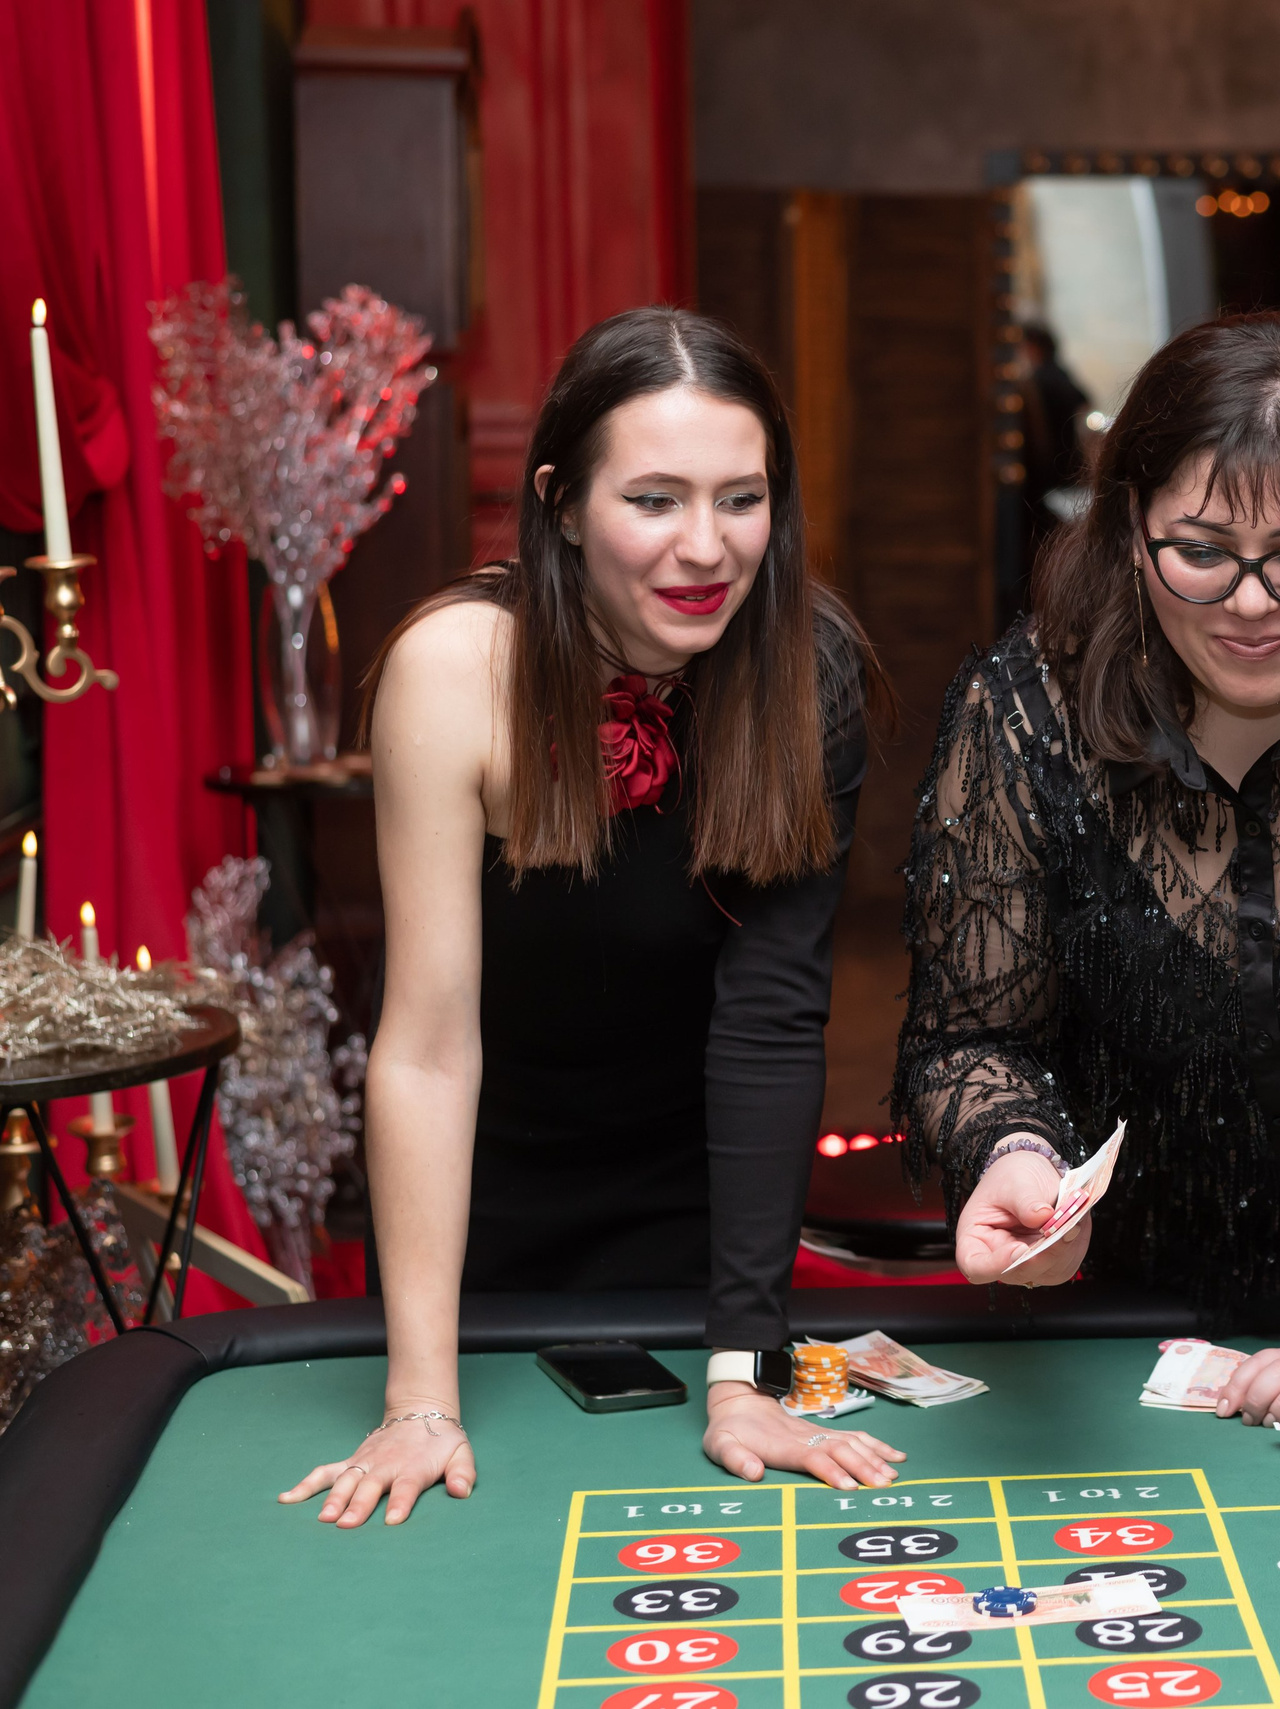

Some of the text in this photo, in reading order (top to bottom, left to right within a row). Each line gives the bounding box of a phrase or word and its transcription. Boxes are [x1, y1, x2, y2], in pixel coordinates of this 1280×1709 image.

[835, 1494, 953, 1511] 2 to 1
[1042, 1486, 1160, 1503] 2 to 1
[623, 1502, 743, 1518] 2 to 1
[855, 1533, 940, 1558] 35
[1069, 1524, 1155, 1549] 34
[635, 1542, 723, 1565] 36
[631, 1588, 722, 1614] 33
[861, 1630, 954, 1655] 29
[1091, 1617, 1185, 1645] 28
[625, 1637, 722, 1666] 30
[865, 1680, 962, 1709] 26
[1106, 1669, 1201, 1700] 25
